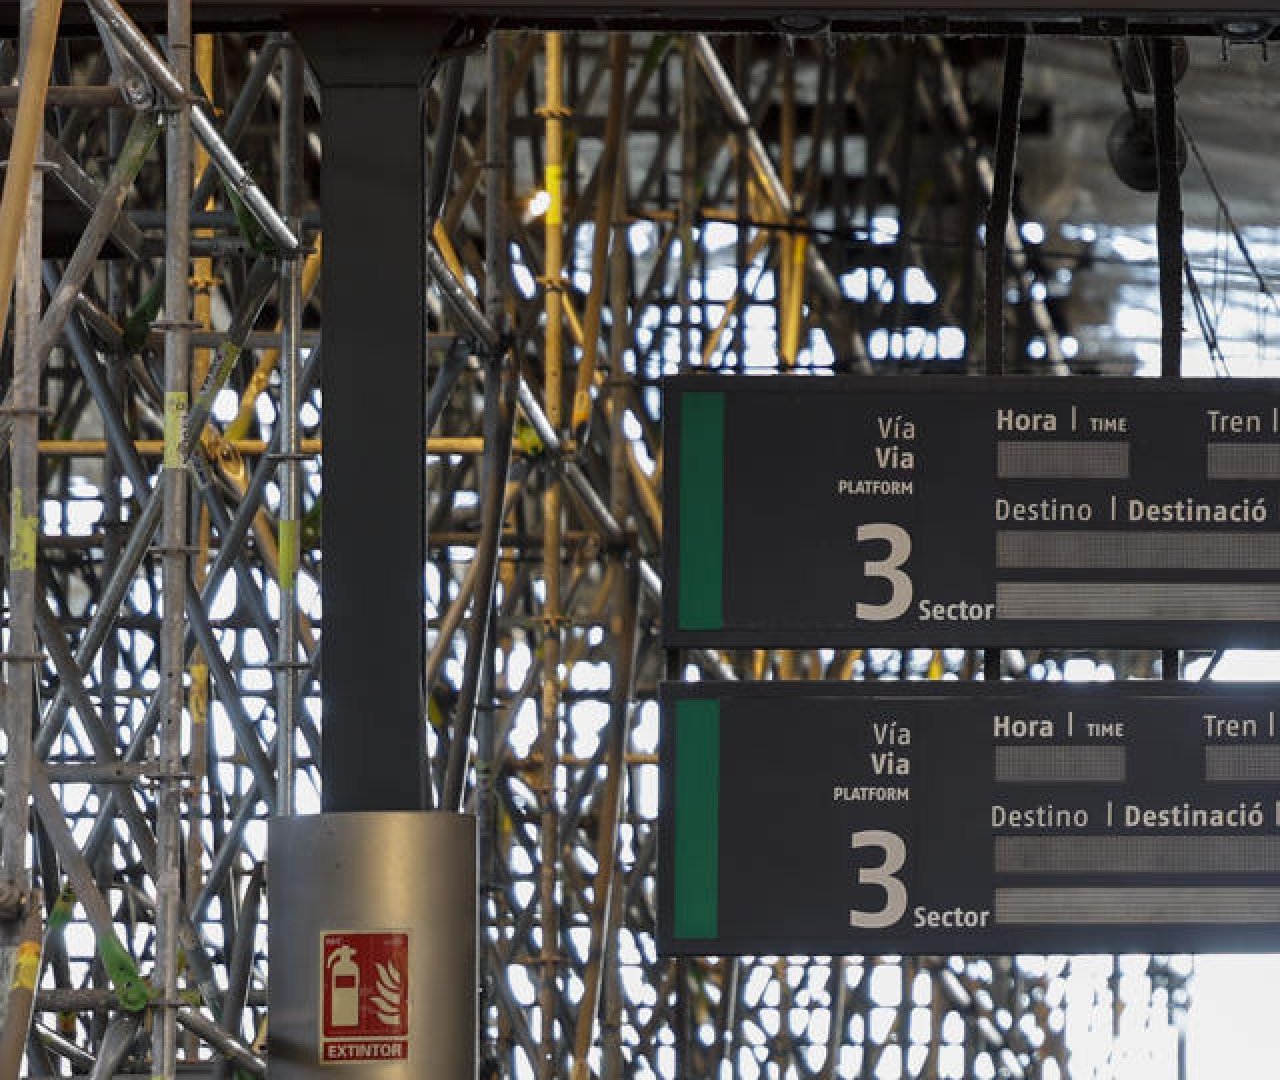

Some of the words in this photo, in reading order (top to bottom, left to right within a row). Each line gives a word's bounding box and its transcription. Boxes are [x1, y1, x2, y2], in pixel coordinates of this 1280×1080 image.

[878, 416, 914, 440] Vía
[998, 410, 1056, 430] Hora
[1090, 418, 1126, 432] TIME
[1208, 410, 1260, 432] Tren
[876, 446, 914, 468] Via
[840, 480, 912, 494] PLATFORM
[996, 498, 1092, 520] Destino
[1130, 498, 1266, 522] Destinació
[856, 524, 912, 620] 3
[918, 599, 995, 621] Sector
[874, 722, 910, 744] Vía
[994, 716, 1052, 736] Hora
[1088, 724, 1124, 736] TIME
[1204, 716, 1256, 736] Tren
[872, 752, 908, 774] Via
[834, 788, 908, 800] PLATFORM
[992, 806, 1088, 826] Destino
[1126, 802, 1262, 826] Destinació
[850, 830, 906, 928] 3
[914, 906, 990, 928] Sector
[328, 1045, 401, 1058] EXTINTOR
